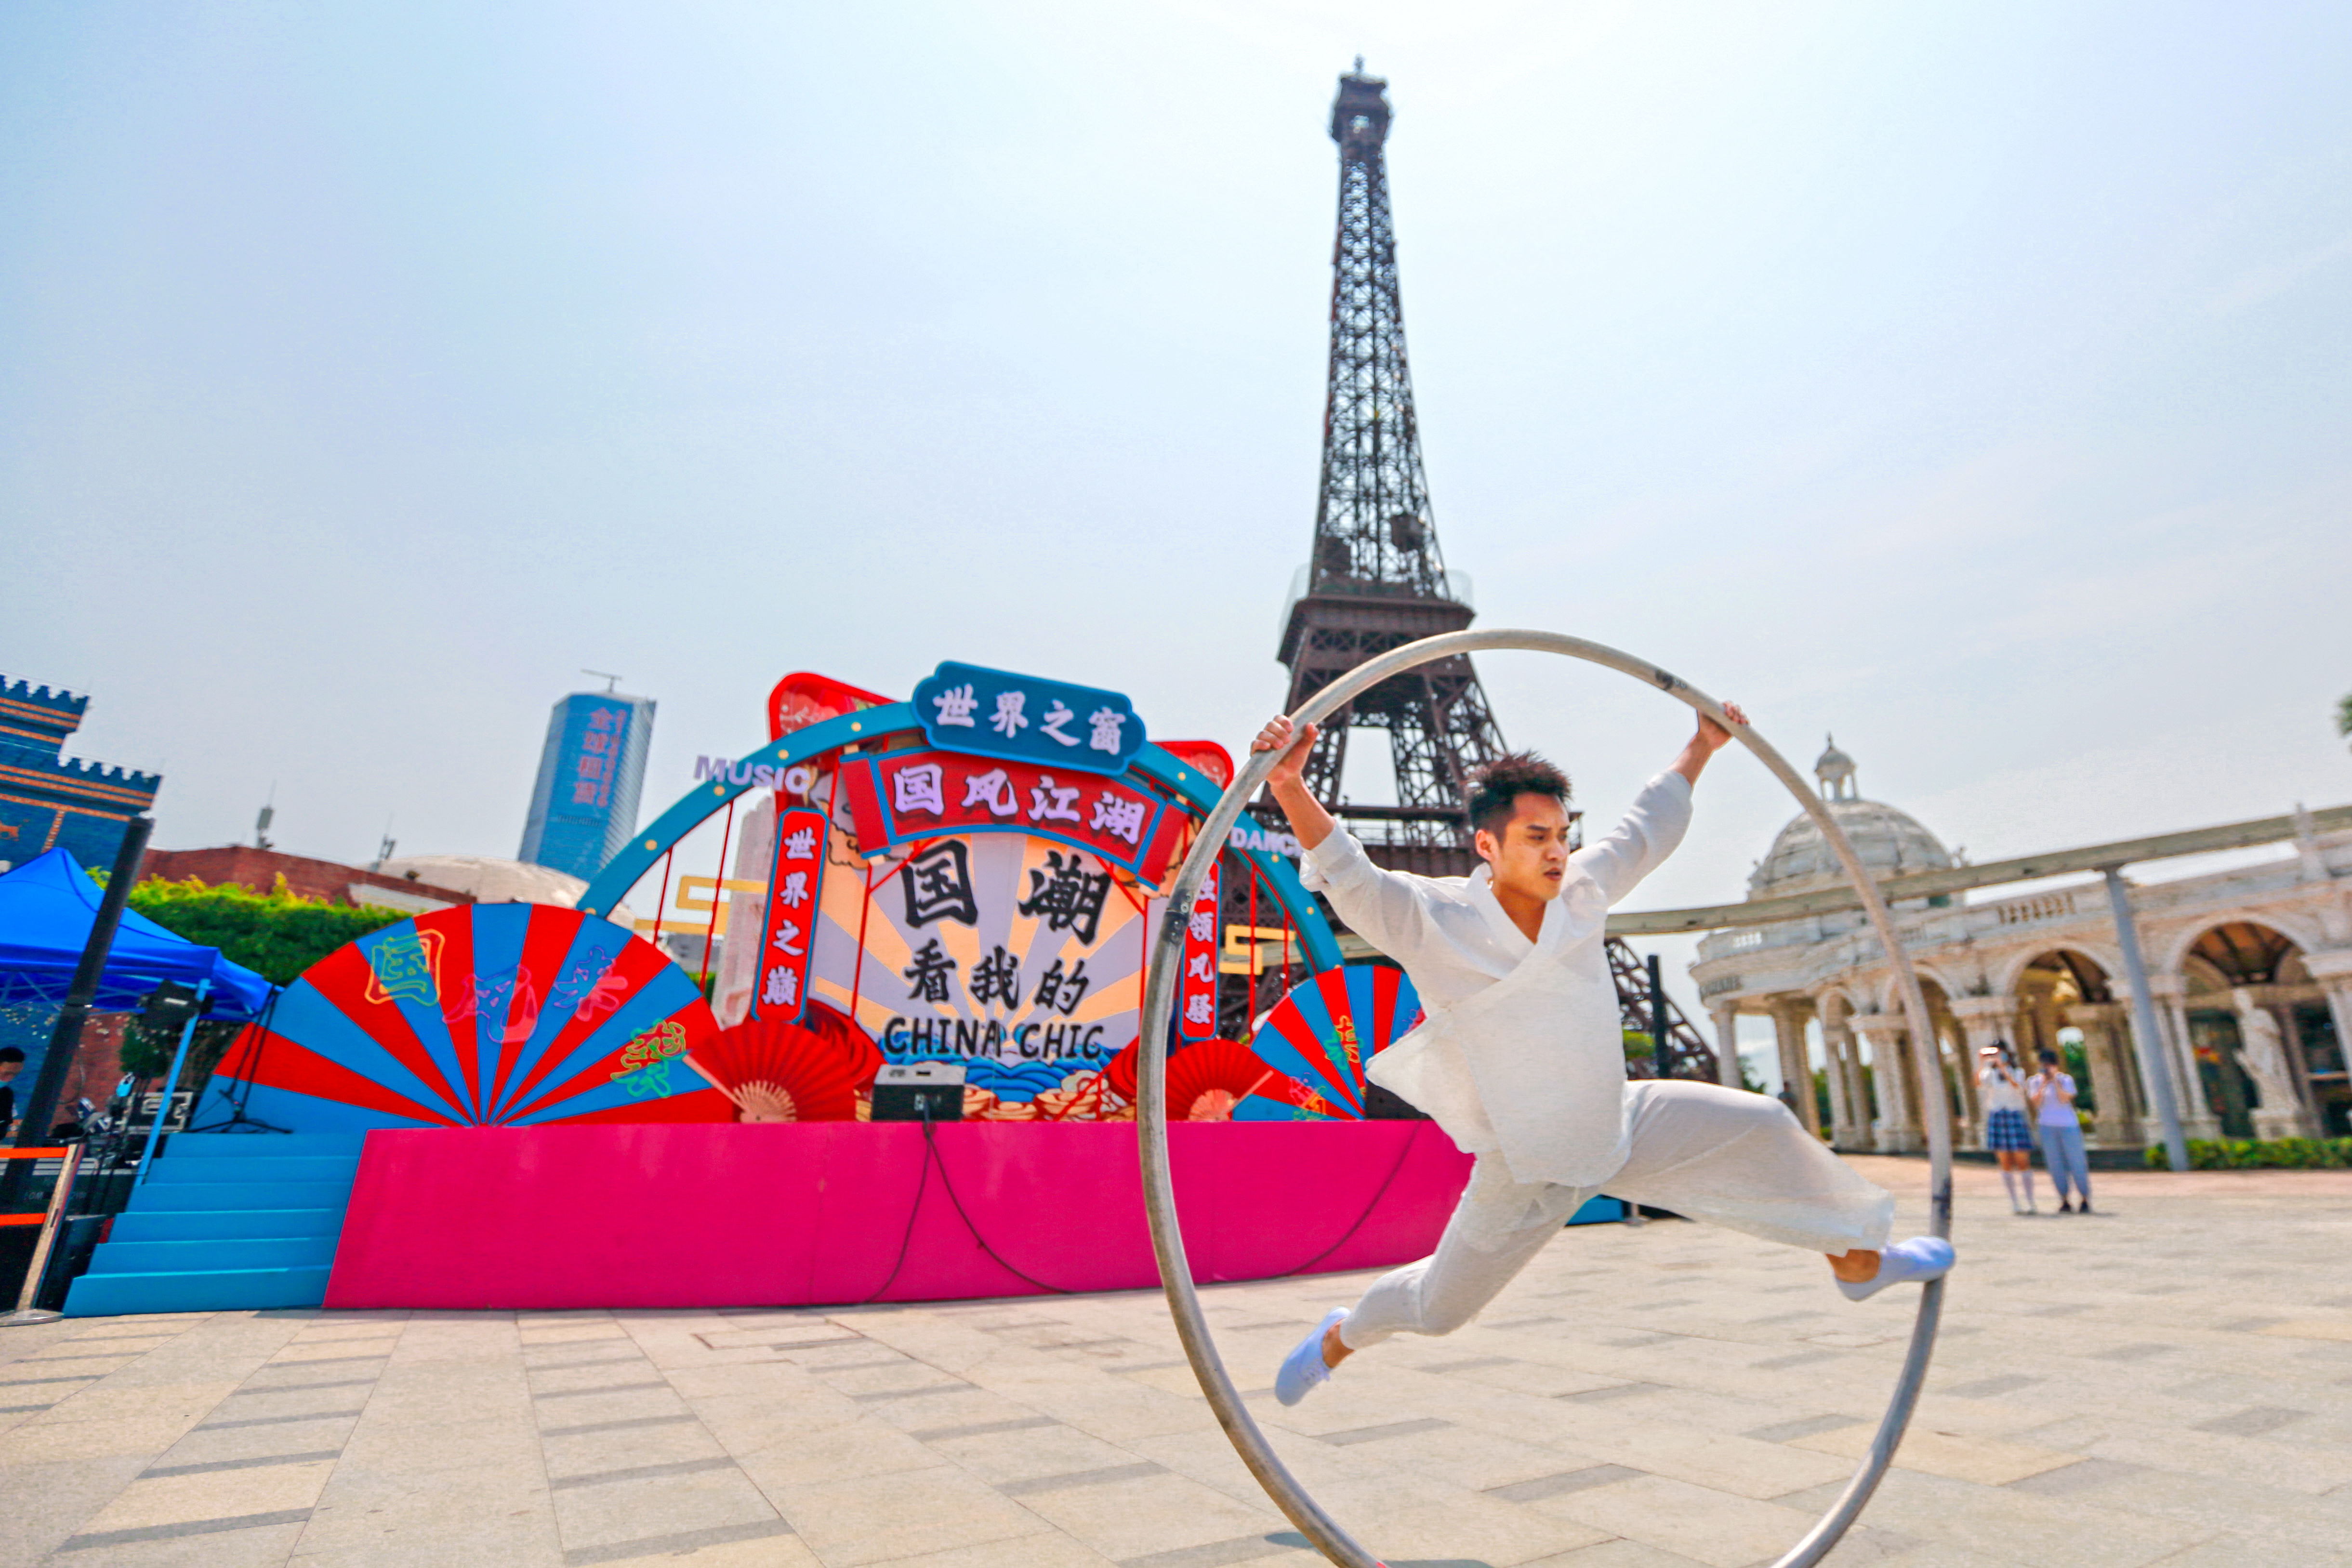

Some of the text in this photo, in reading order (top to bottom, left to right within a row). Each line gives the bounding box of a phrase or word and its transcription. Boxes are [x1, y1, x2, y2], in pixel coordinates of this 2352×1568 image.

[932, 683, 1126, 755] 世界之窗
[693, 755, 810, 795] MUSIC
[893, 763, 1146, 844] 国风江湖
[761, 826, 817, 1006] 世界之巅
[901, 840, 1112, 945] 国潮
[904, 938, 1090, 1016] 看我的
[885, 1016, 1104, 1059] CHINA CHIC
